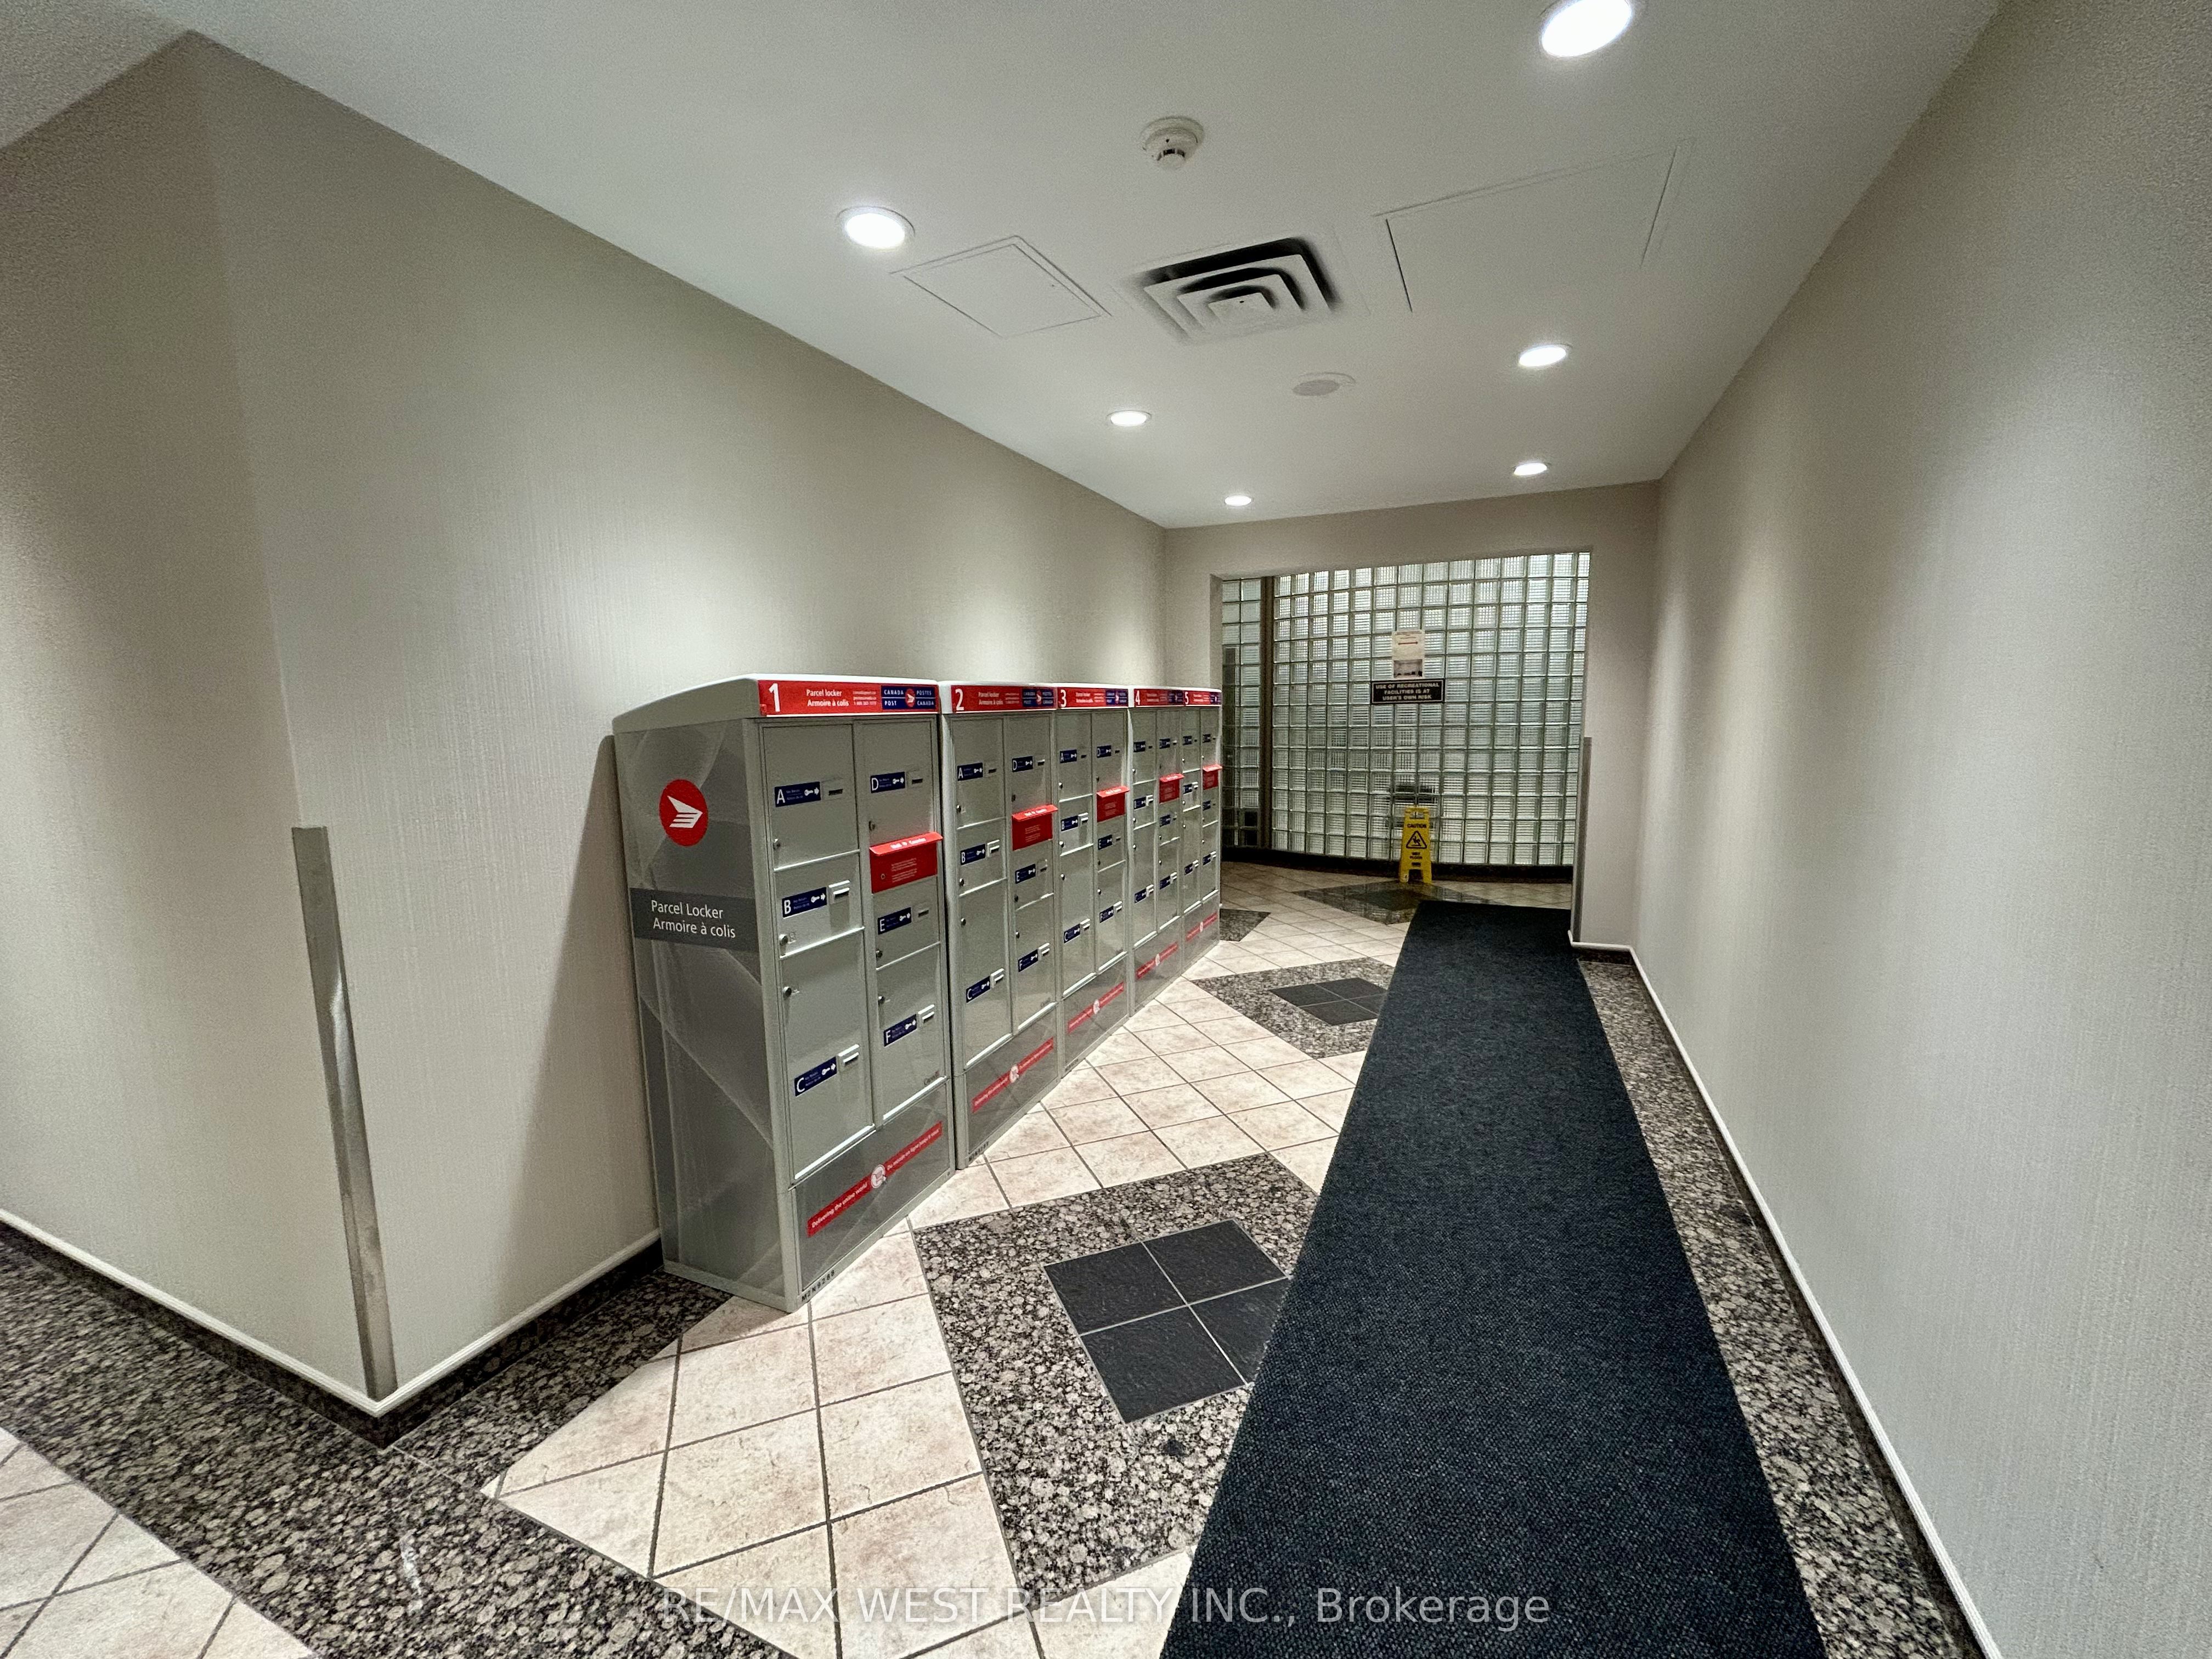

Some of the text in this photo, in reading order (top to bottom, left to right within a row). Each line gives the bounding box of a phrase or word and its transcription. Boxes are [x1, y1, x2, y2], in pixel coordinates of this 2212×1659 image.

[769, 683, 781, 712] 1
[955, 689, 964, 711] 2
[1060, 689, 1067, 707] 3
[1135, 690, 1140, 705] 4
[1184, 692, 1189, 704] 5
[1012, 760, 1018, 770] D
[958, 768, 963, 779] A
[872, 777, 879, 791] D
[776, 789, 786, 804] A
[961, 852, 966, 863] B
[1016, 871, 1020, 882] E
[651, 900, 724, 919] Parcel Locker
[784, 900, 791, 915] B
[653, 917, 736, 938] Armoire à colis
[879, 918, 885, 932] E
[1019, 960, 1023, 970] F
[967, 989, 972, 1000] C
[886, 1030, 891, 1043] F
[797, 1077, 805, 1093] C
